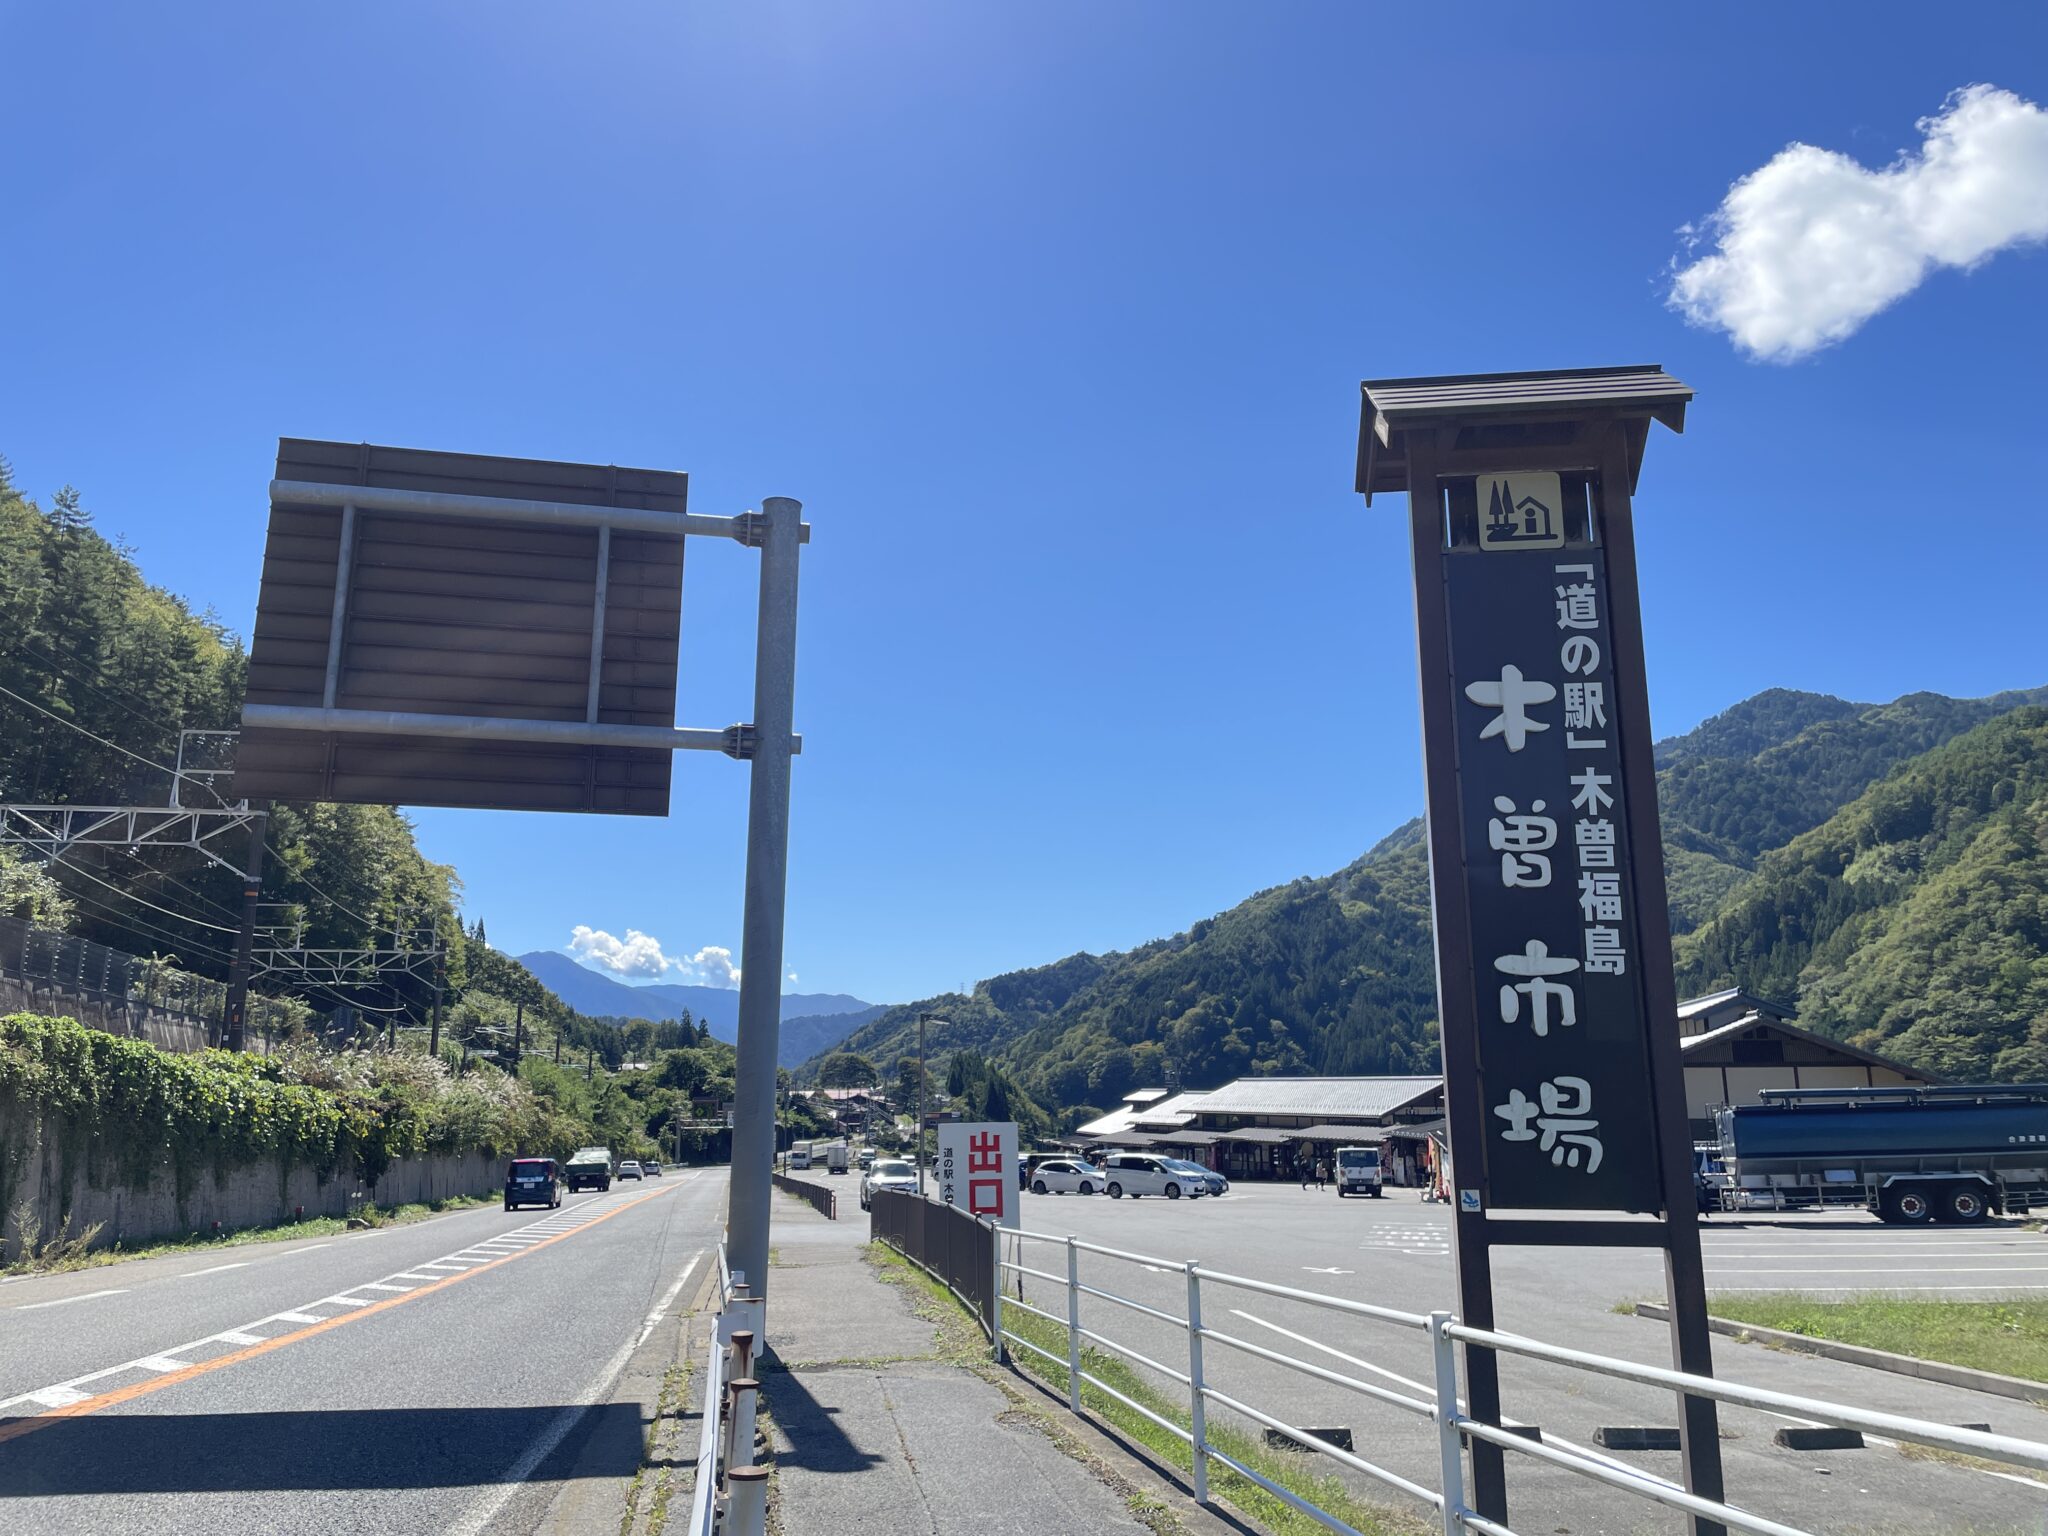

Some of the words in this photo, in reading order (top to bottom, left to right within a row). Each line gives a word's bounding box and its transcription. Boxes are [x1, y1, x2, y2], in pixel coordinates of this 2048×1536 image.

[1464, 664, 1604, 1175] 木曽市場
[968, 1131, 1004, 1218] 出口
